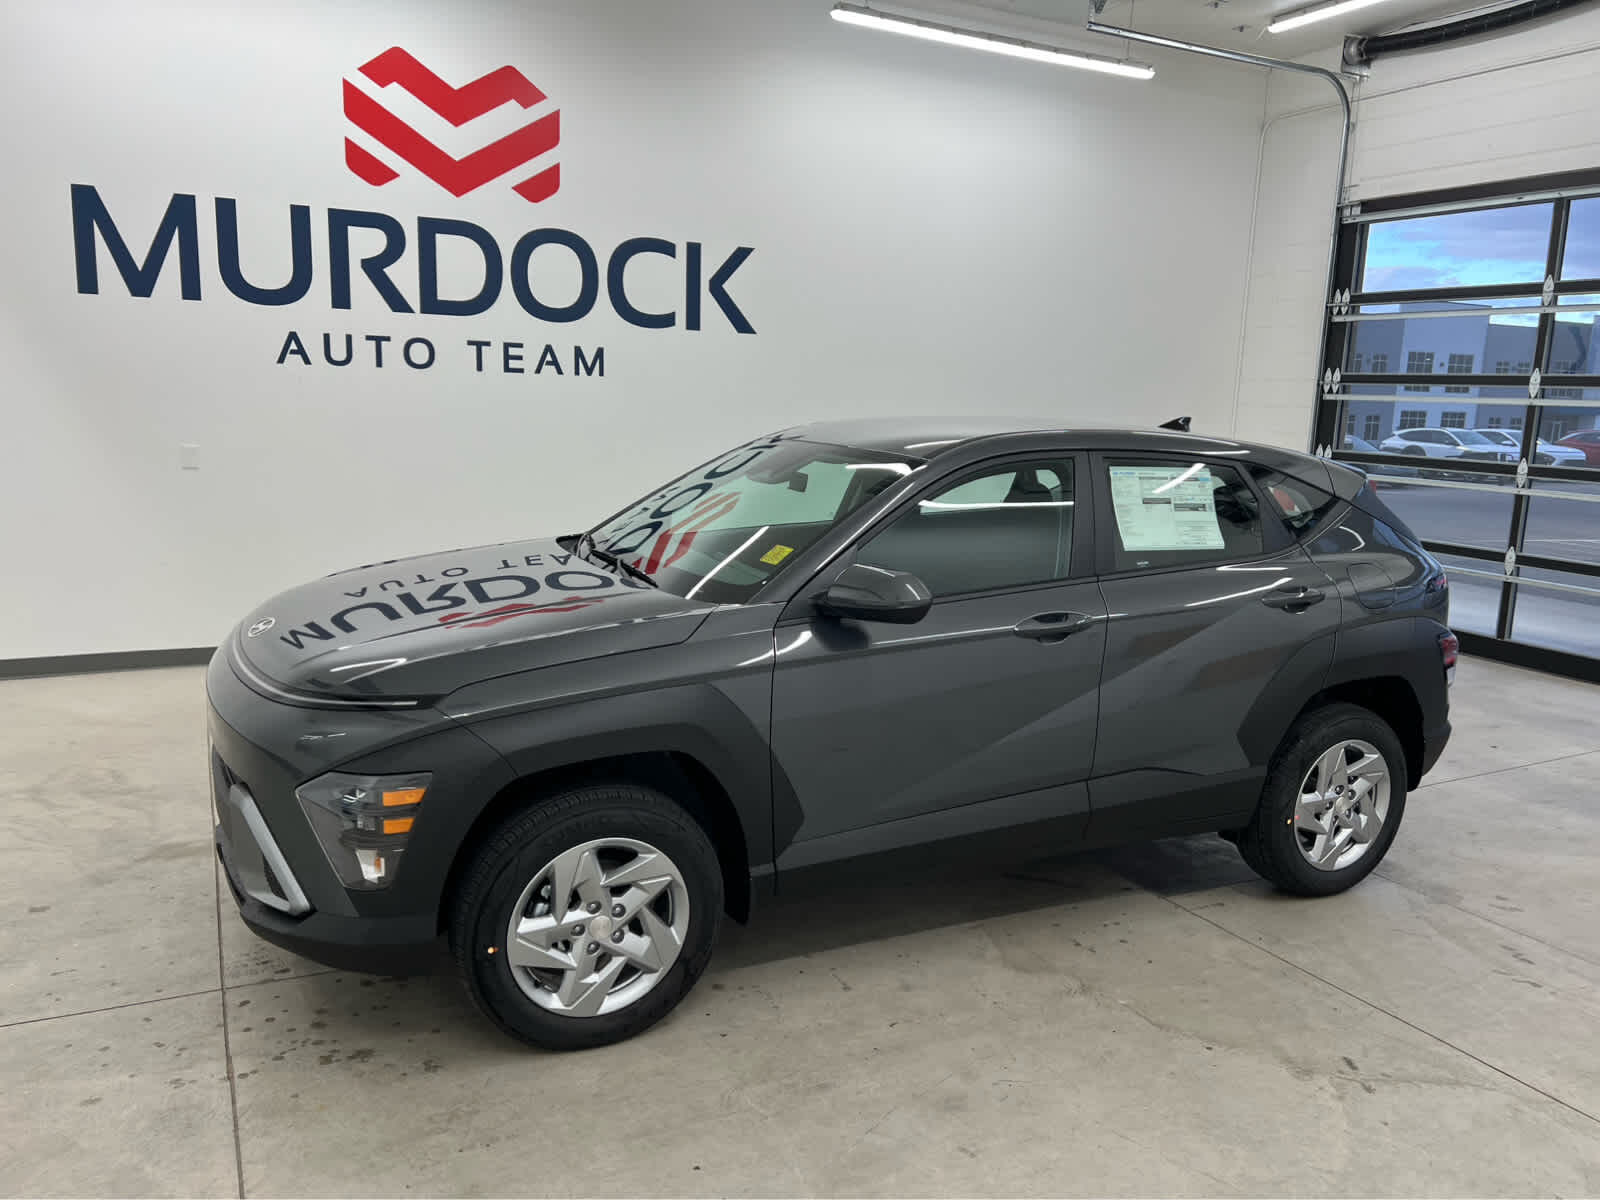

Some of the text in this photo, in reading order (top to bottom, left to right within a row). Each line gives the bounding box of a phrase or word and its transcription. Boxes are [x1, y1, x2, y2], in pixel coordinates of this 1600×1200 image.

[71, 183, 757, 335] MURDOCK
[276, 331, 605, 377] AUTO TEAM
